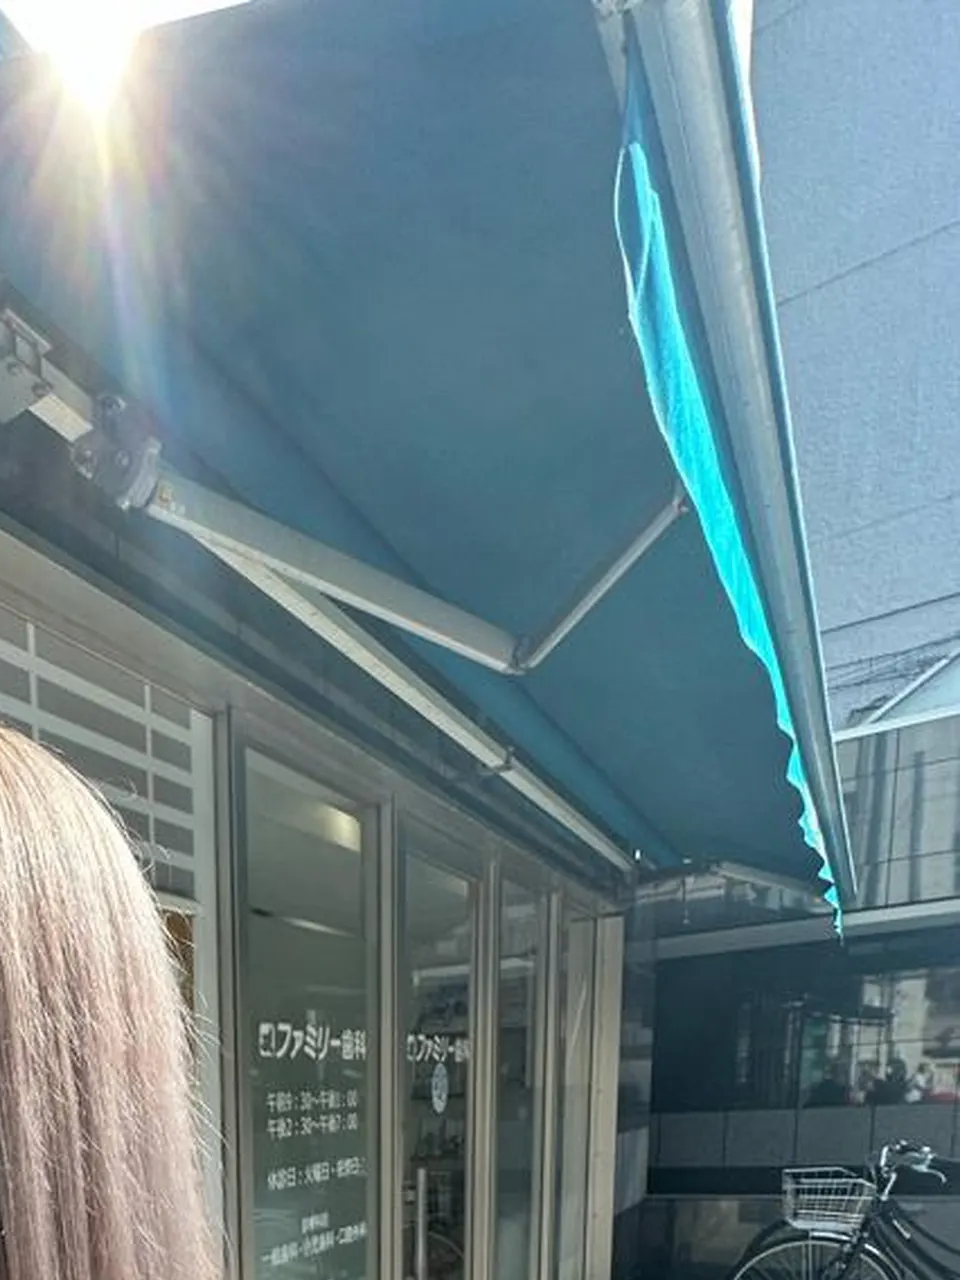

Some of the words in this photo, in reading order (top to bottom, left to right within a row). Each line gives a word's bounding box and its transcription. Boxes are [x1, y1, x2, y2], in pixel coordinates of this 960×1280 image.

[276, 1022, 366, 1060] ファミリー歯科
